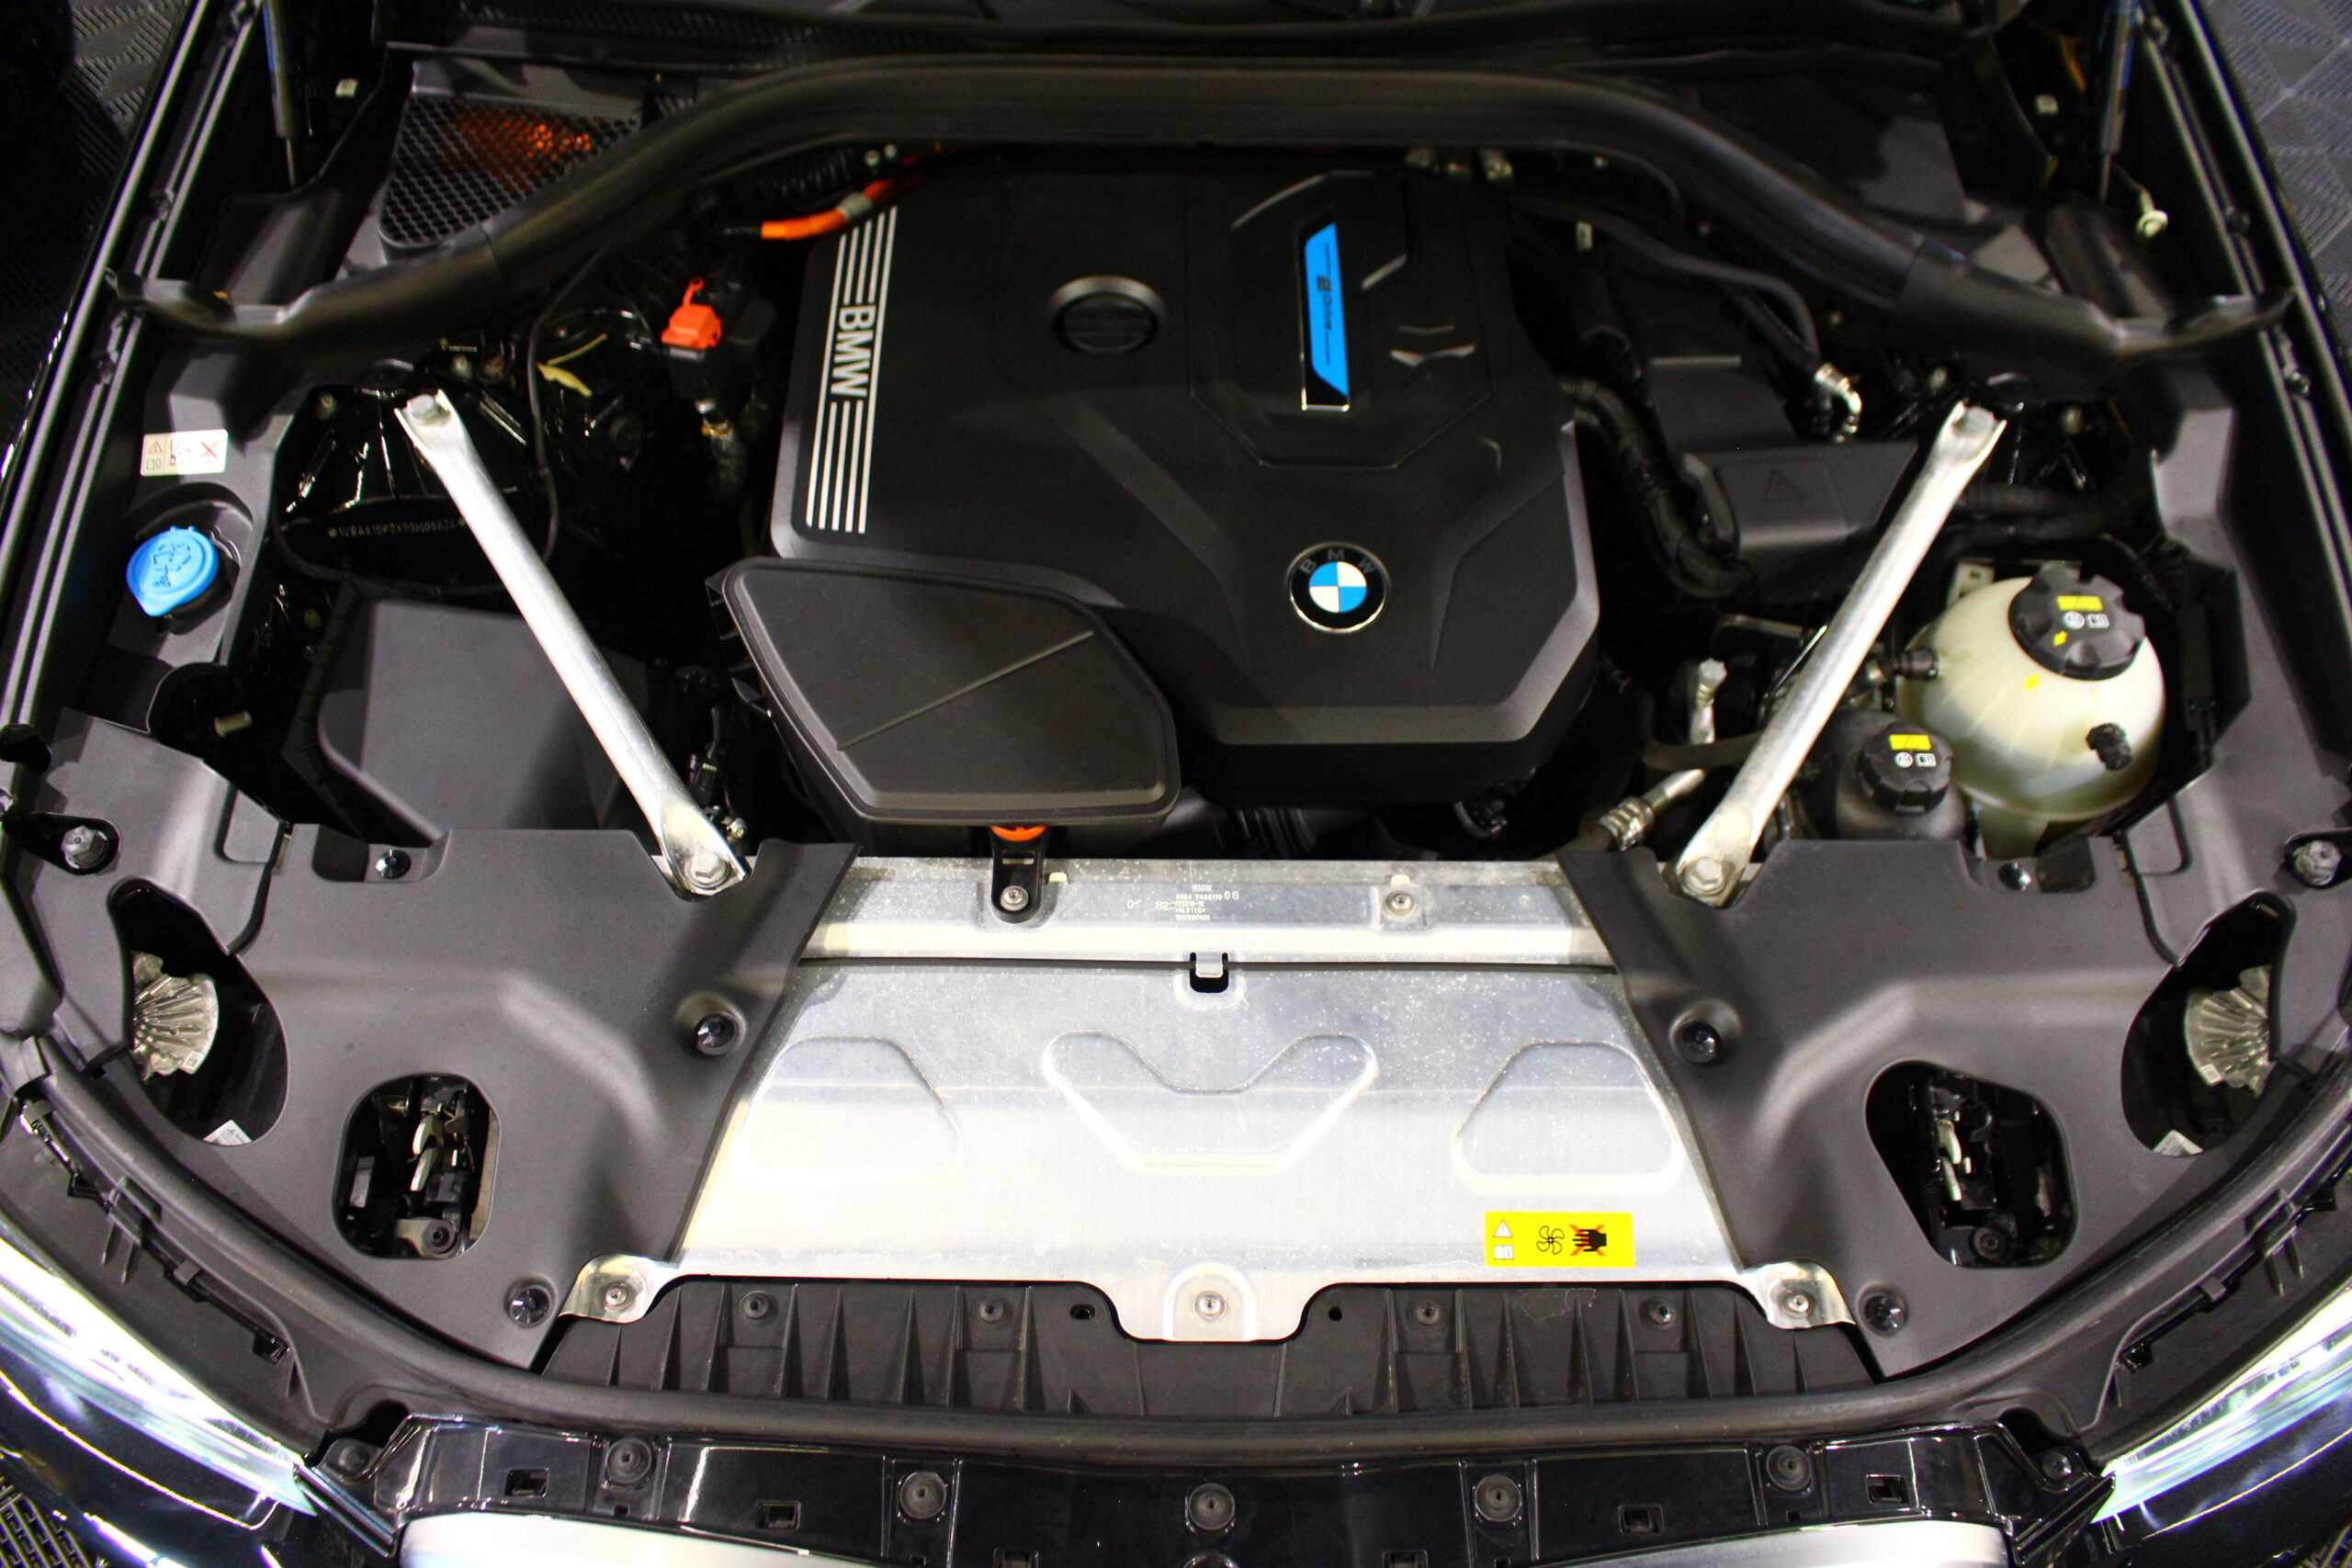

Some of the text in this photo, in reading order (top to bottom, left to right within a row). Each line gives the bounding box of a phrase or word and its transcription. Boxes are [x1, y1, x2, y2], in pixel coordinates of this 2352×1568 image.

[831, 305, 876, 397] BMW
[1299, 548, 1379, 574] BMW
[1192, 884, 1212, 892] BMW
